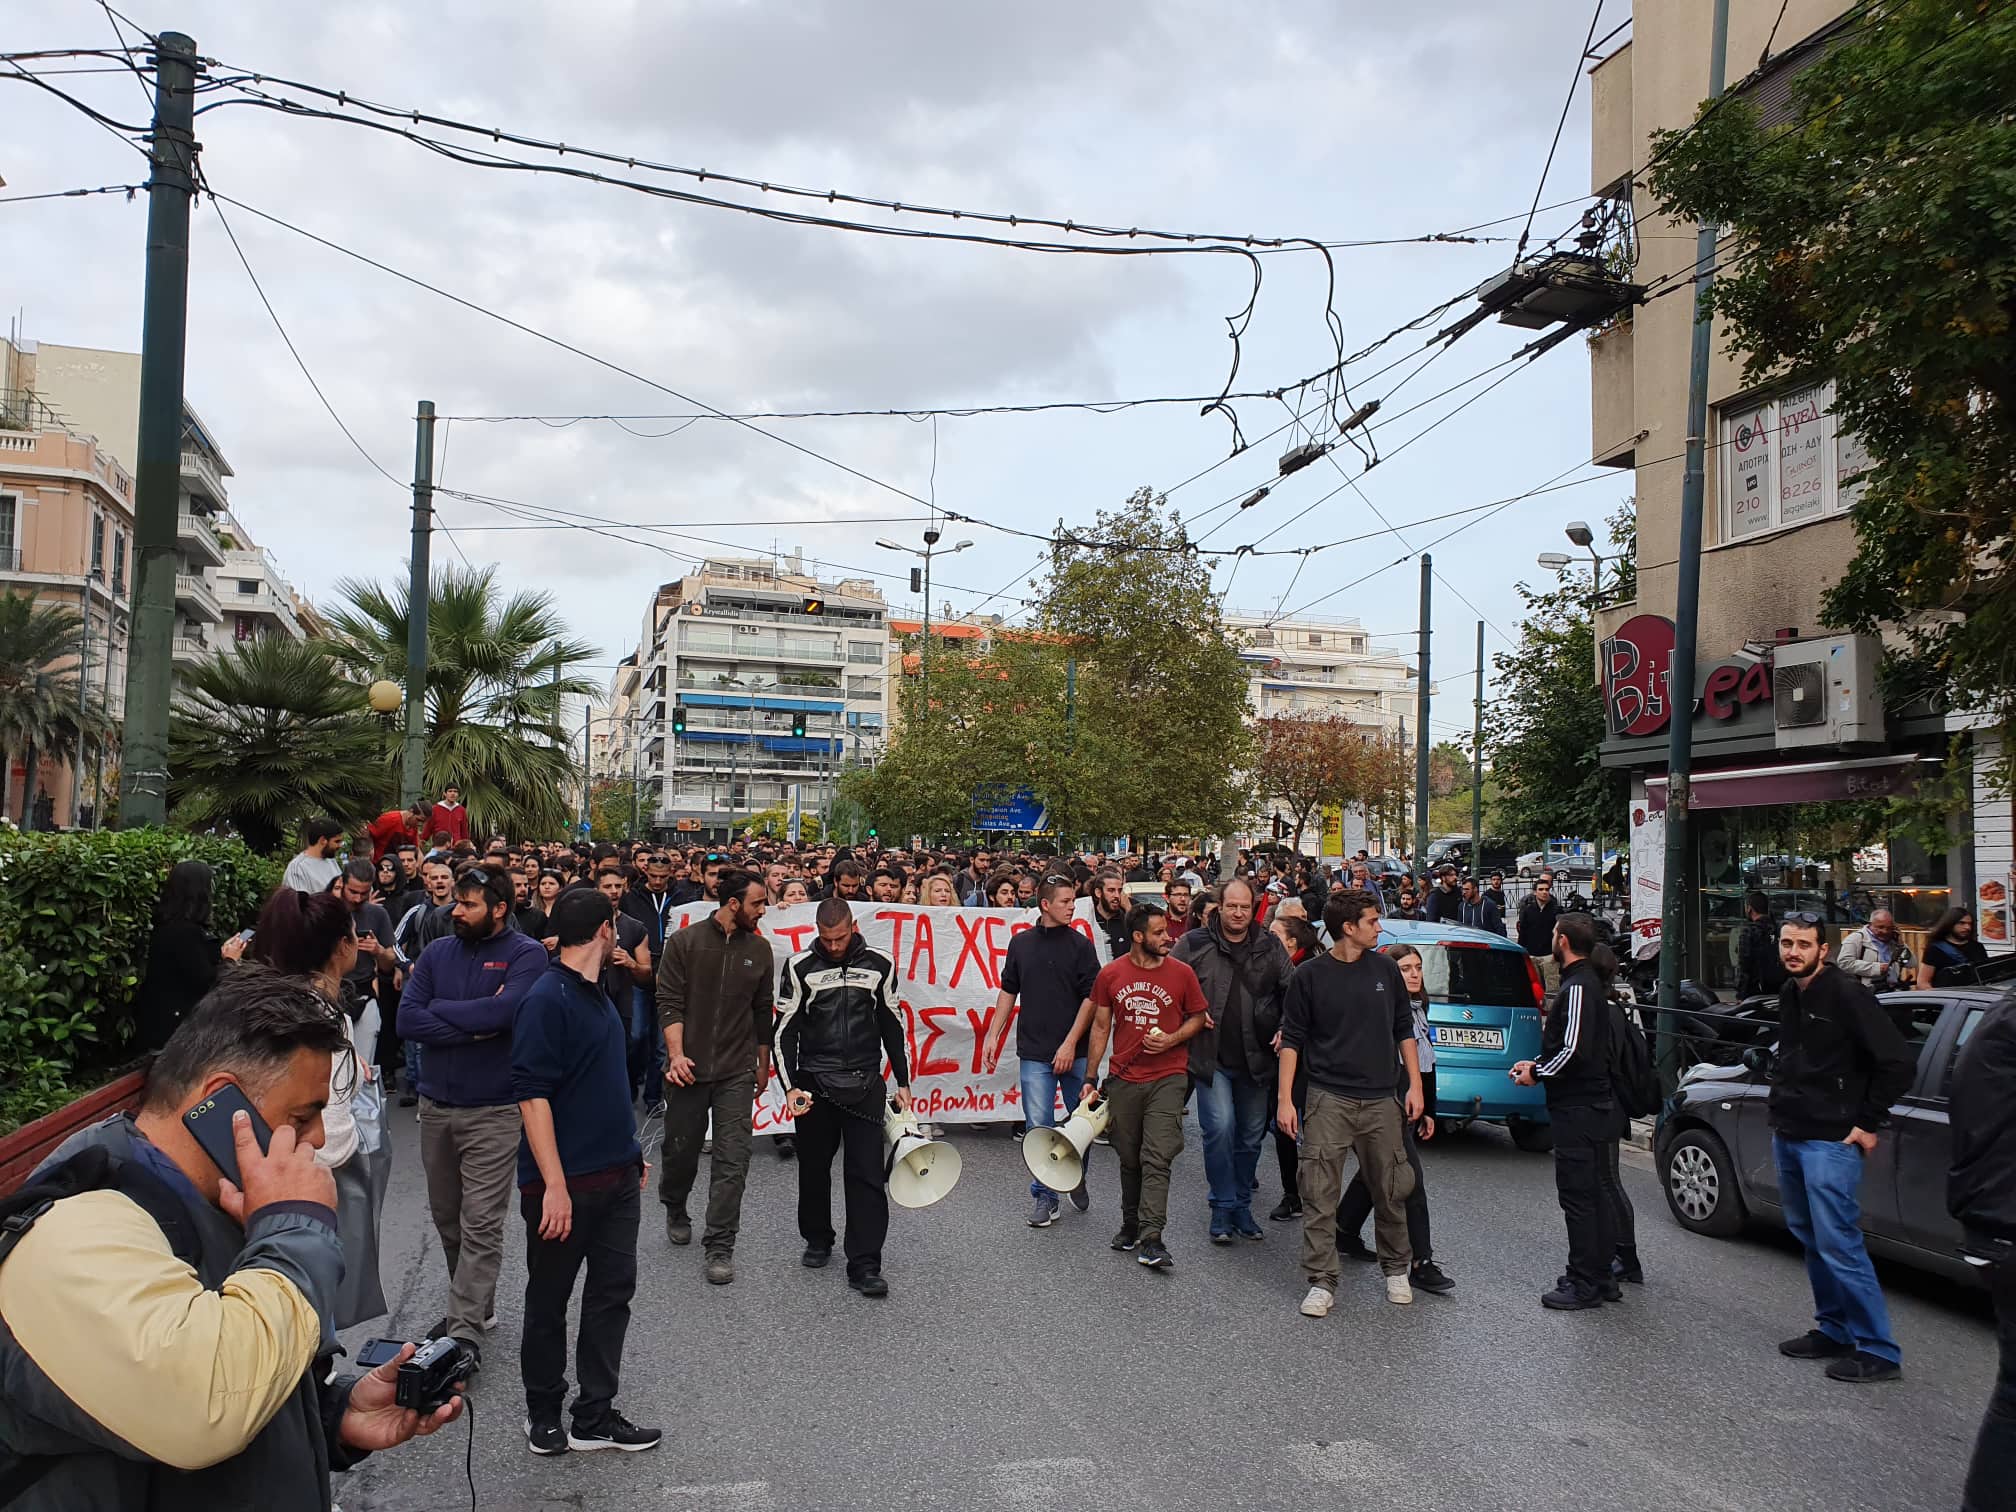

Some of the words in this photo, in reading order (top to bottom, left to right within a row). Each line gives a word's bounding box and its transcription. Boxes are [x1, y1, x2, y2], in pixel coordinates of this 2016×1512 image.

[1737, 496, 1760, 514] 210
[1782, 478, 1822, 500] 8226
[1703, 662, 1774, 720] ea
[876, 911, 936, 985] ΤΑ
